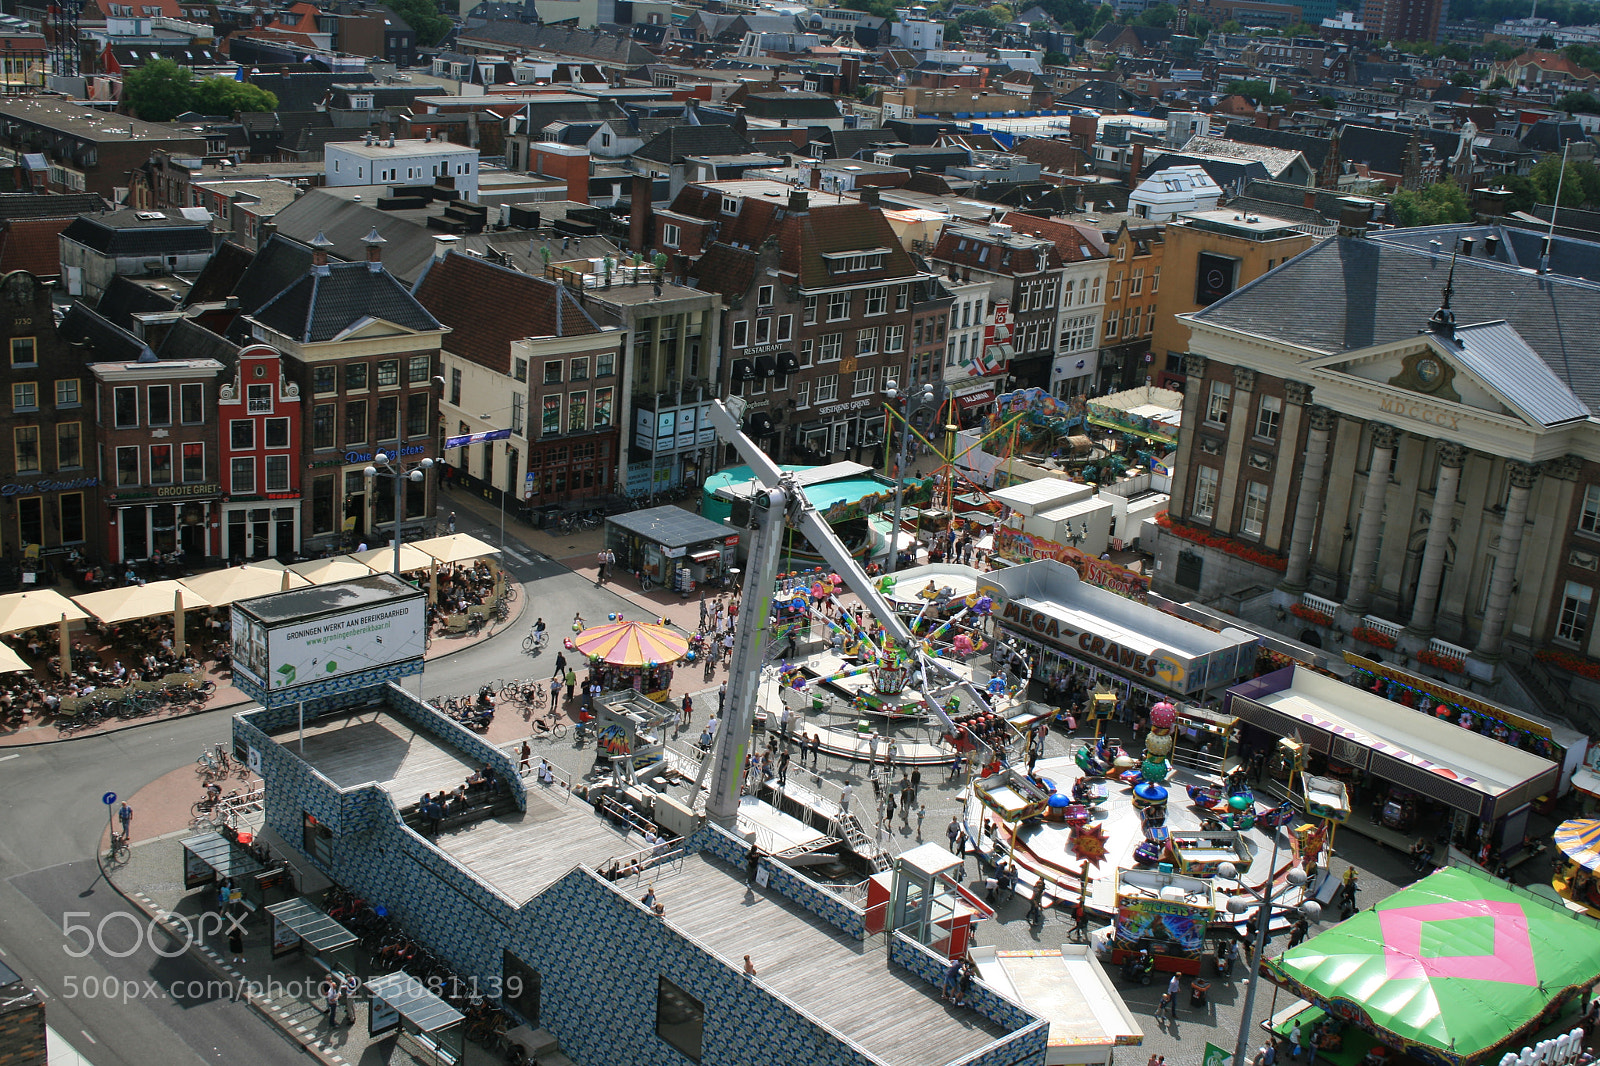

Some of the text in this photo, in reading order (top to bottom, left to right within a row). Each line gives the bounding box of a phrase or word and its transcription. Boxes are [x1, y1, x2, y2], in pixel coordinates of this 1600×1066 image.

[743, 344, 783, 356] RESTAURANT
[850, 398, 871, 411] GRENE
[962, 391, 990, 404] TALAMINI
[1380, 398, 1461, 430] MDCCCX
[344, 450, 372, 464] Drie
[158, 484, 217, 497] GROOTE GRIET
[1018, 542, 1058, 560] LUCKY
[1087, 562, 1131, 594] SALOON
[286, 607, 409, 641] GRONINGEN WERKT AAN BEREIKBAARHEID
[306, 620, 391, 646] www.groningenbereikbaar.nl
[1380, 668, 1510, 722] CRAZY GAME PALACE
[1141, 901, 1189, 917] TICKETS
